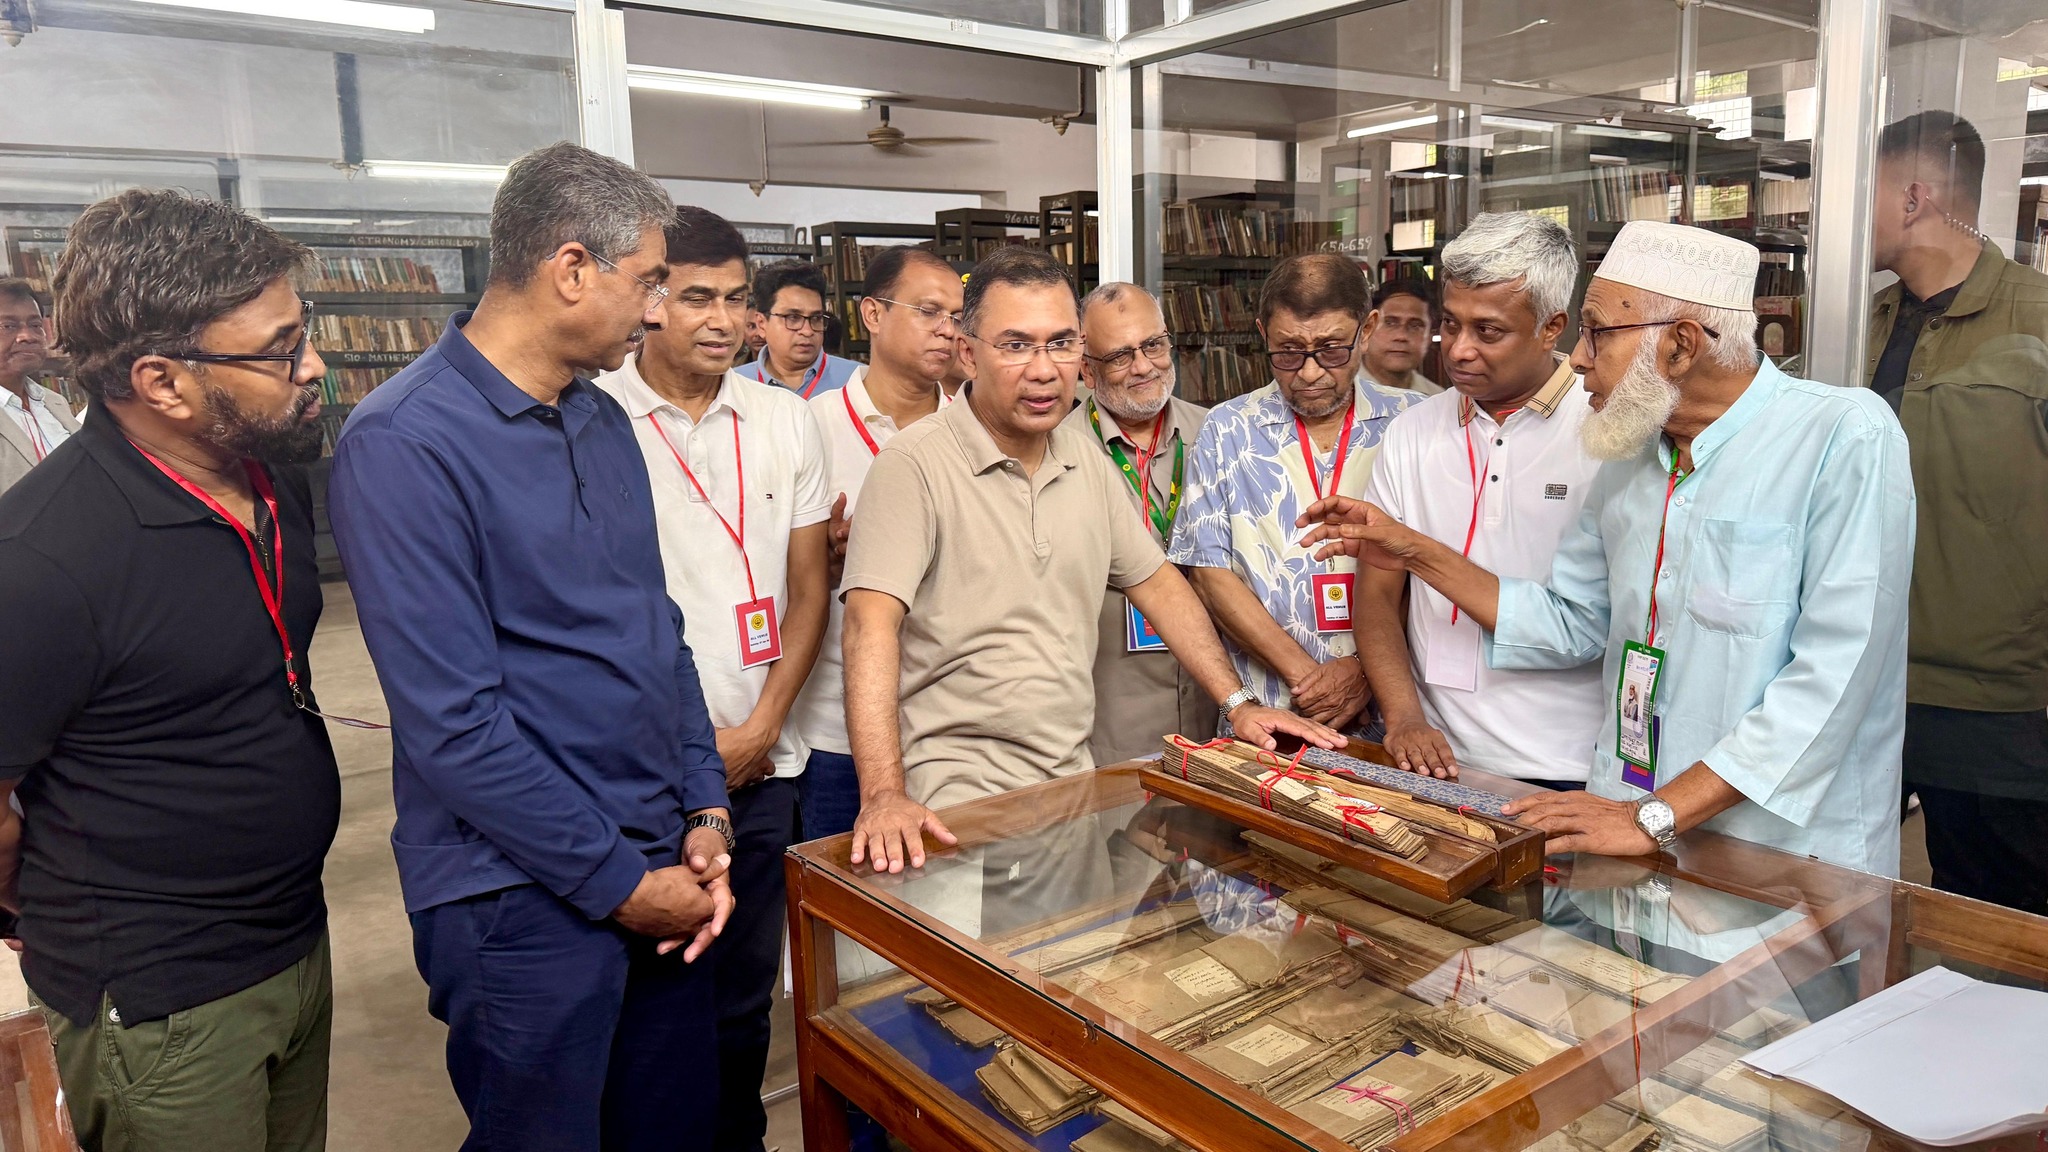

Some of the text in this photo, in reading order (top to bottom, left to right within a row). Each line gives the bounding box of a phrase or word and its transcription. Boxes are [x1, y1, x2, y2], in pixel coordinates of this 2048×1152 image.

[1004, 213, 1022, 224] 960
[1213, 333, 1259, 346] MEDICAL
[368, 353, 421, 362] MATHEMAT
